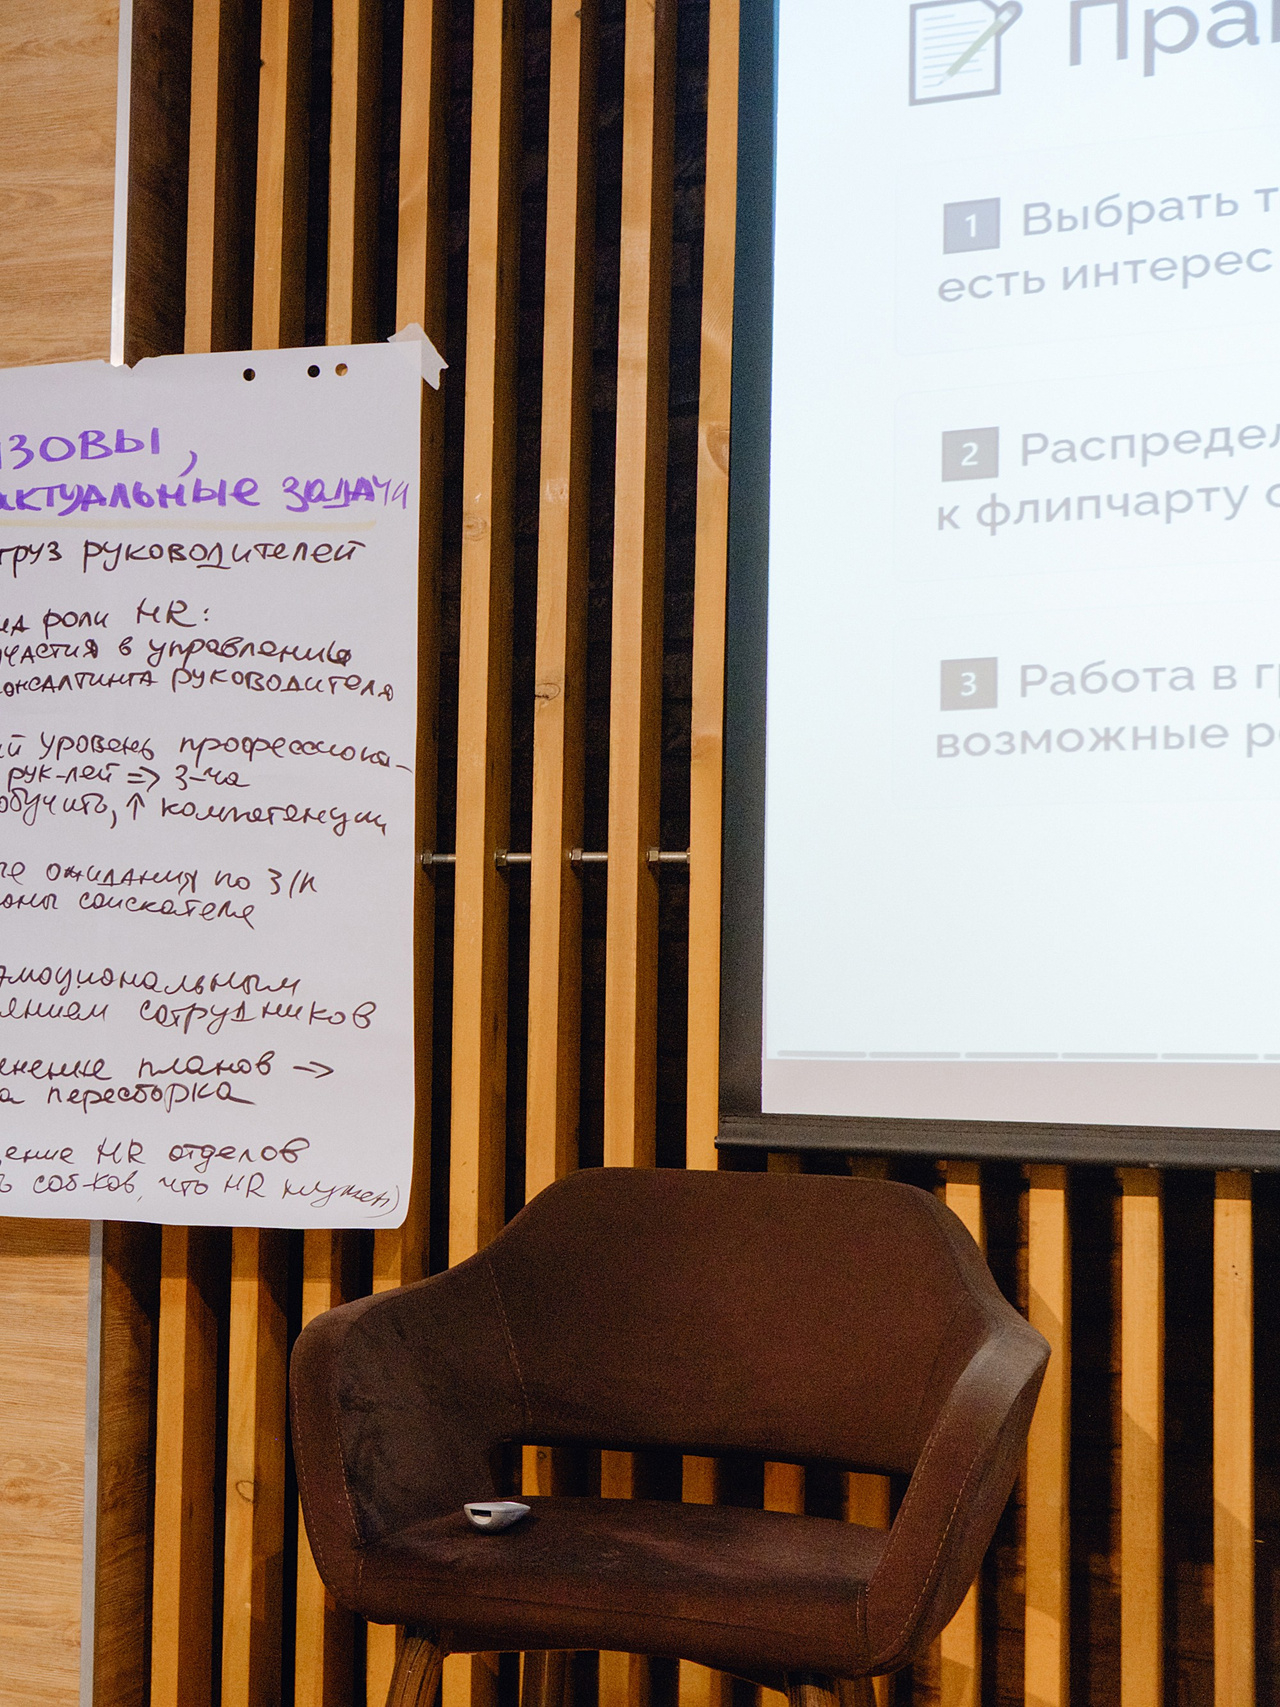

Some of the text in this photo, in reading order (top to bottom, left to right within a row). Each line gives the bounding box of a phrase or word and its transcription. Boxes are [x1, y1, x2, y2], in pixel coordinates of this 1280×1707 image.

[1069, 0, 1280, 78] Пра
[1022, 192, 1240, 236] Выбрать
[938, 247, 1274, 302] есть интерес
[282, 474, 410, 513] задачи
[936, 505, 962, 532] к
[976, 485, 1250, 537] флипчарту
[82, 540, 366, 573] руководителей
[42, 608, 109, 639] роли
[118, 636, 134, 656] в
[172, 667, 394, 701] руководителя
[1019, 660, 1197, 698] Работа
[1213, 664, 1238, 690] в
[936, 722, 1230, 758] возможные
[6, 763, 121, 793] рук-лей
[46, 862, 198, 896] ожидания
[214, 869, 251, 891] по
[79, 891, 255, 930] соискателя
[139, 999, 377, 1036] сотрудников
[138, 1050, 276, 1078] планов
[47, 1081, 257, 1114] пересборка
[97, 1137, 146, 1165] HR
[168, 1137, 311, 1174] отделов
[158, 1175, 209, 1198] что
[223, 1172, 266, 1199] HR
[281, 1178, 401, 1219] нужен)
